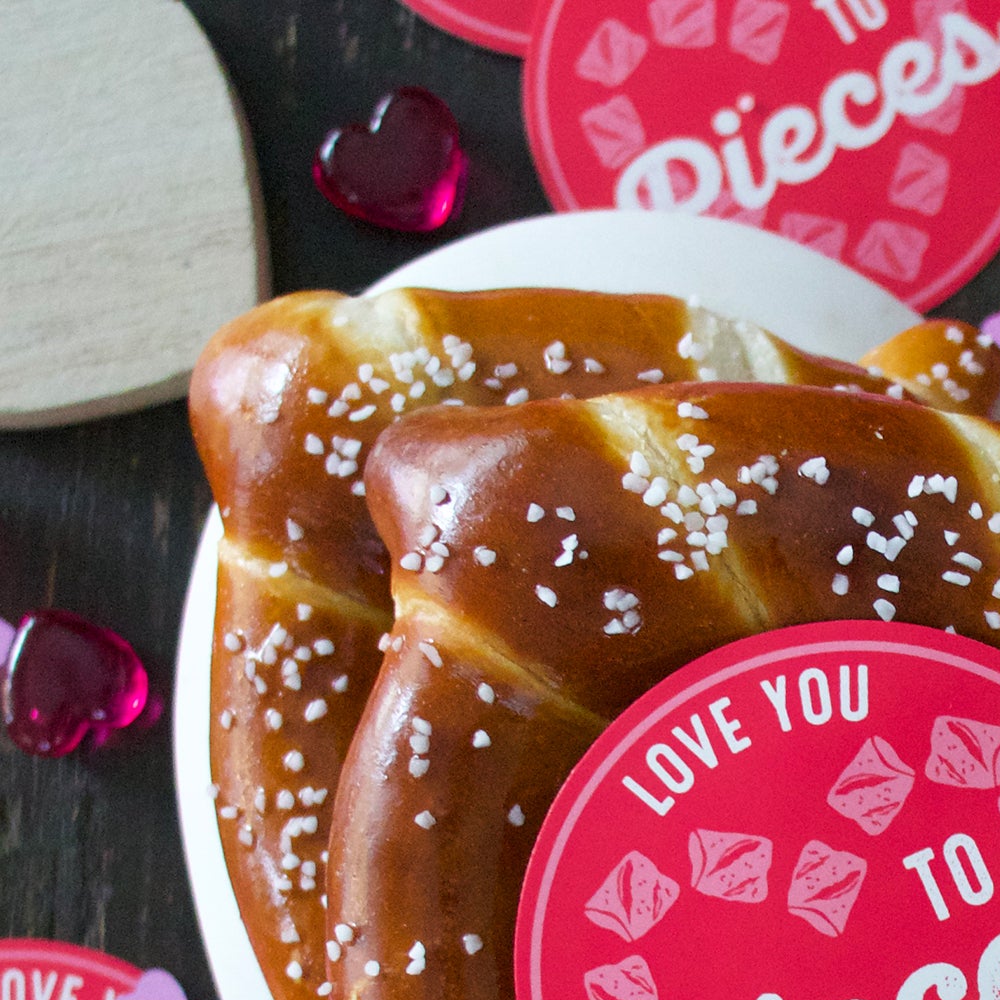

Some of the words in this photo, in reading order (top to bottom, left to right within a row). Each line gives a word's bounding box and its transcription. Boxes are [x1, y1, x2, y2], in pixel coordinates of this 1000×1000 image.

[621, 696, 752, 817] LOVE
[760, 664, 869, 732] YOU
[903, 833, 994, 921] TO
